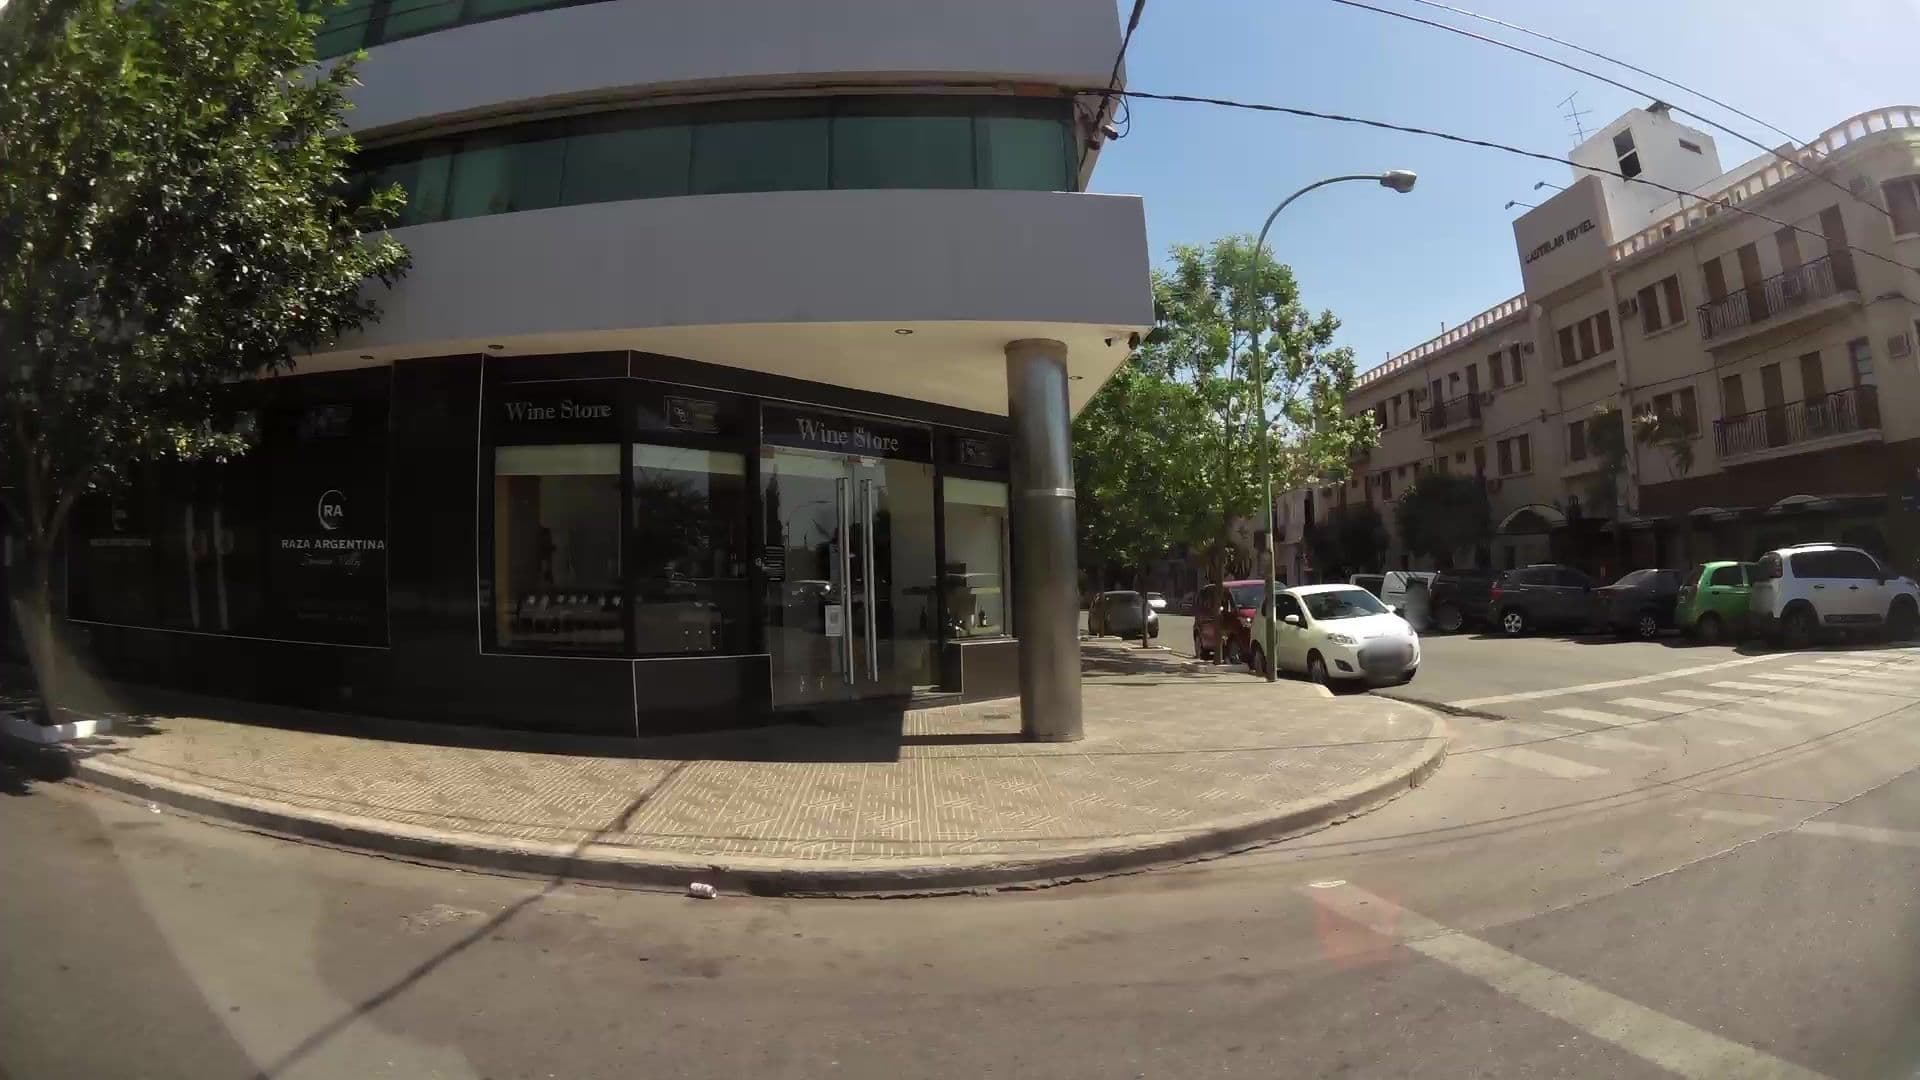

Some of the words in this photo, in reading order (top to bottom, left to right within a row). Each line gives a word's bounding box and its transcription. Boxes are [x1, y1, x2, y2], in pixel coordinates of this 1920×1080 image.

[504, 400, 555, 421] Wine
[560, 399, 612, 419] Store
[796, 417, 848, 444] Wine
[854, 426, 899, 452] Store
[323, 504, 344, 517] RA
[281, 539, 311, 549] RAZA
[314, 539, 385, 550] ARGENTINA
